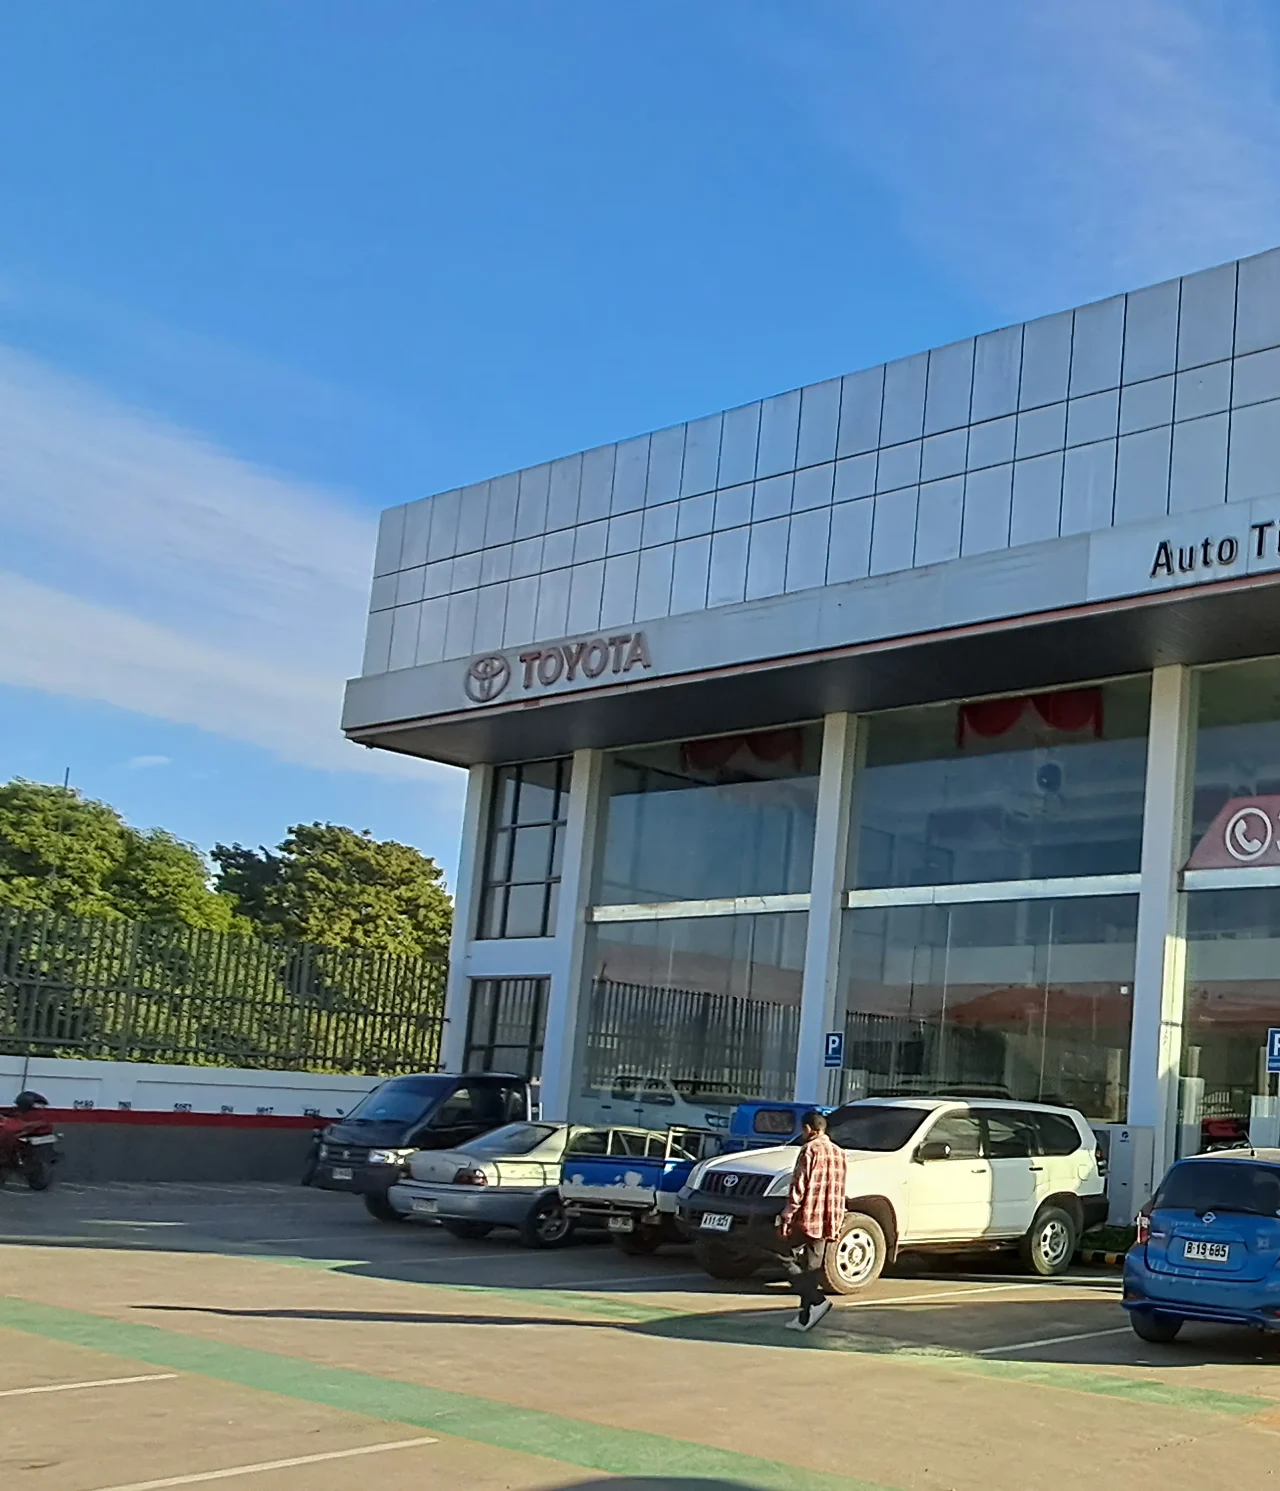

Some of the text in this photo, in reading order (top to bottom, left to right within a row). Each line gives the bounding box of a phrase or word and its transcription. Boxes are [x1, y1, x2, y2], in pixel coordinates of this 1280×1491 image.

[1150, 535, 1238, 578] Auto
[519, 632, 652, 689] TOYOTA
[828, 1035, 840, 1055] P
